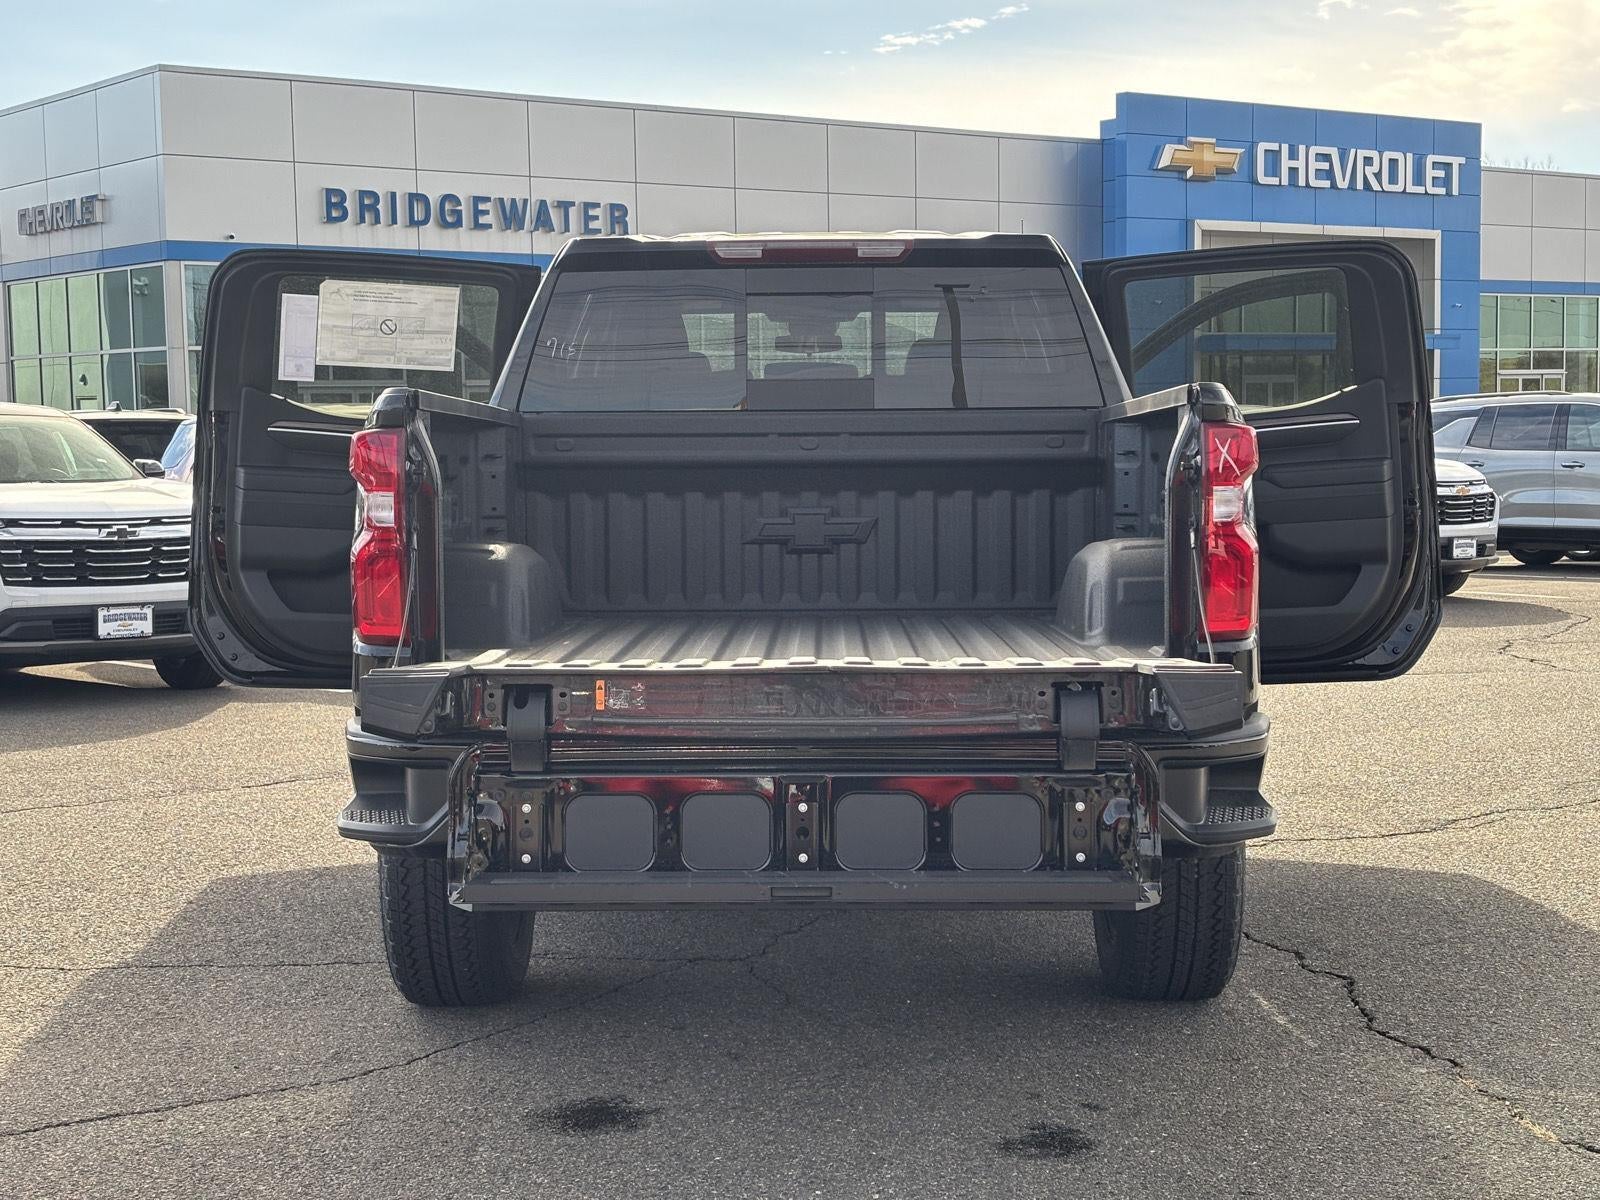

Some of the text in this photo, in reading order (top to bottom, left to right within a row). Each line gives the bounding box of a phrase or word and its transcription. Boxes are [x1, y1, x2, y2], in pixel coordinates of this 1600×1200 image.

[1256, 142, 1466, 196] CHEVROLET
[18, 194, 105, 236] CHEVROLET
[321, 187, 629, 236] BRIDGEWATER
[103, 613, 148, 623] BRIDGEWATER
